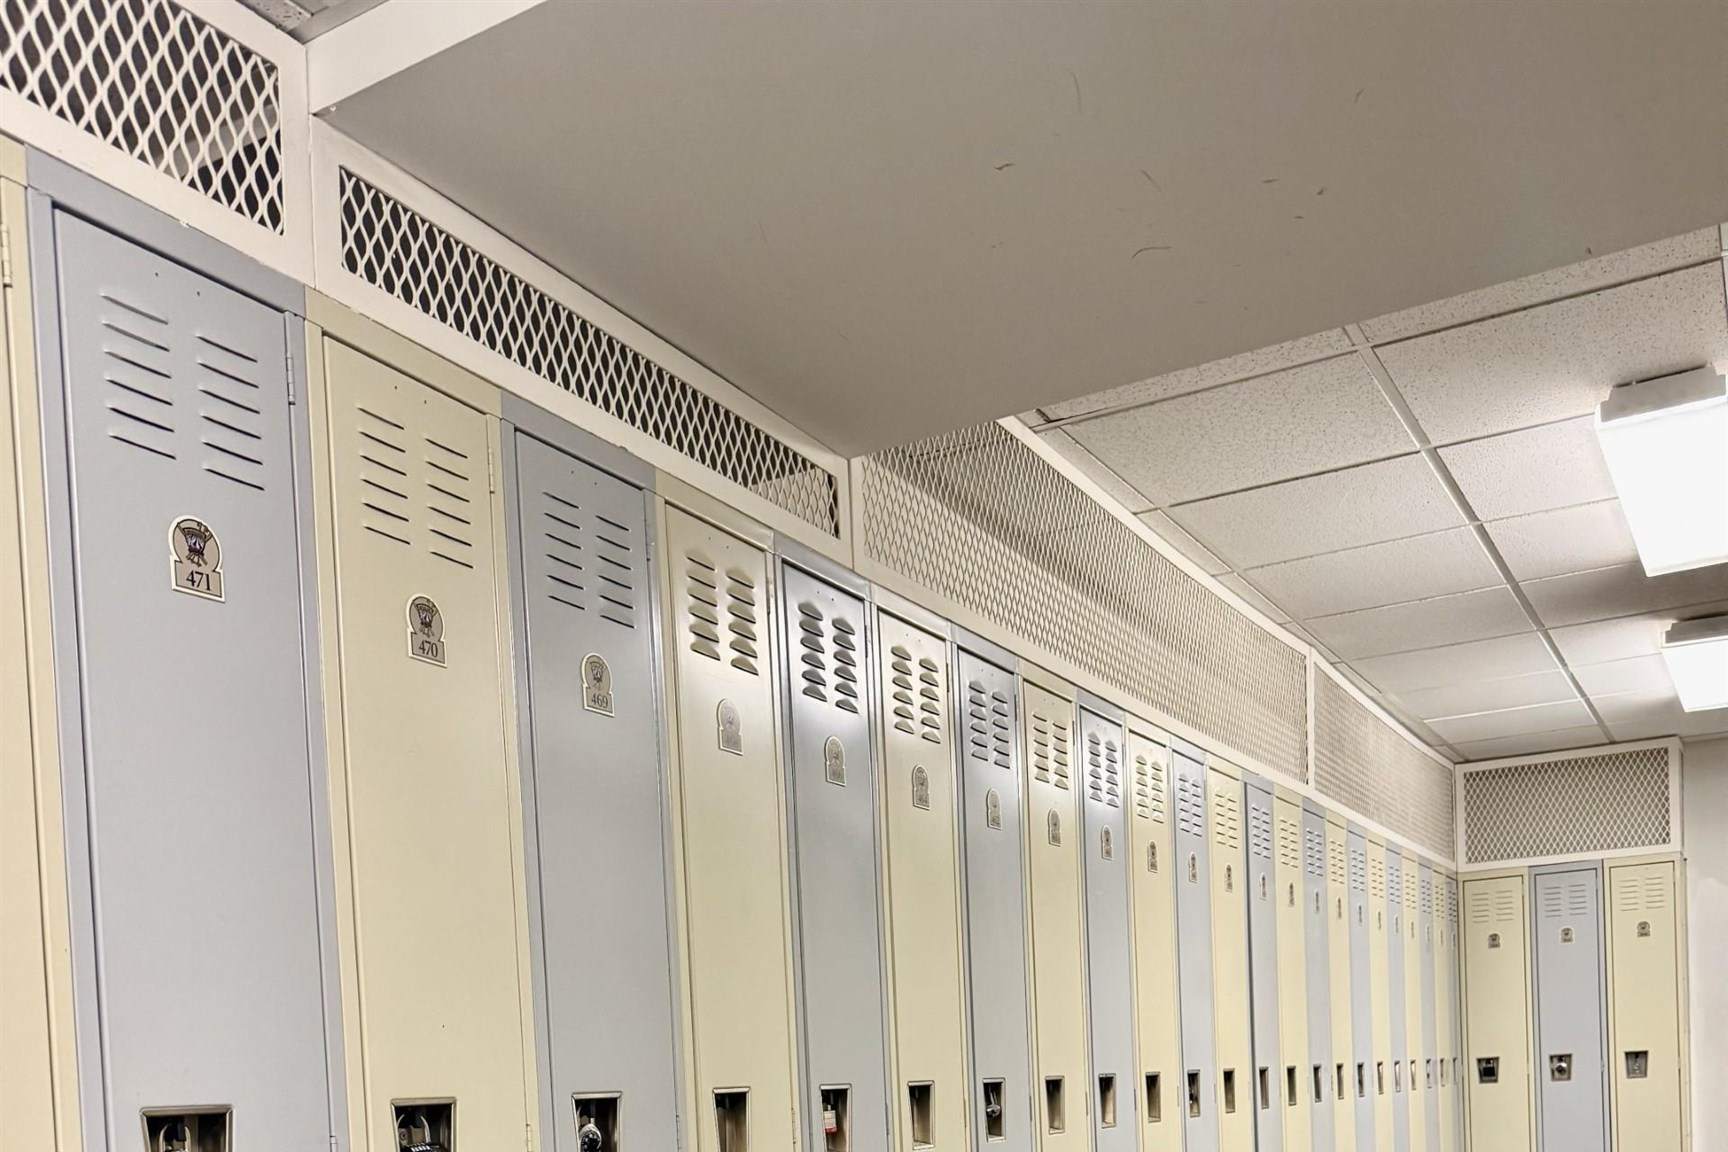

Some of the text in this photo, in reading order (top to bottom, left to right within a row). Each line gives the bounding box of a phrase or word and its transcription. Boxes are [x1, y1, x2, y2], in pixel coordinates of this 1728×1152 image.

[186, 570, 211, 591] 471
[419, 640, 438, 658] 470
[591, 693, 608, 709] 469
